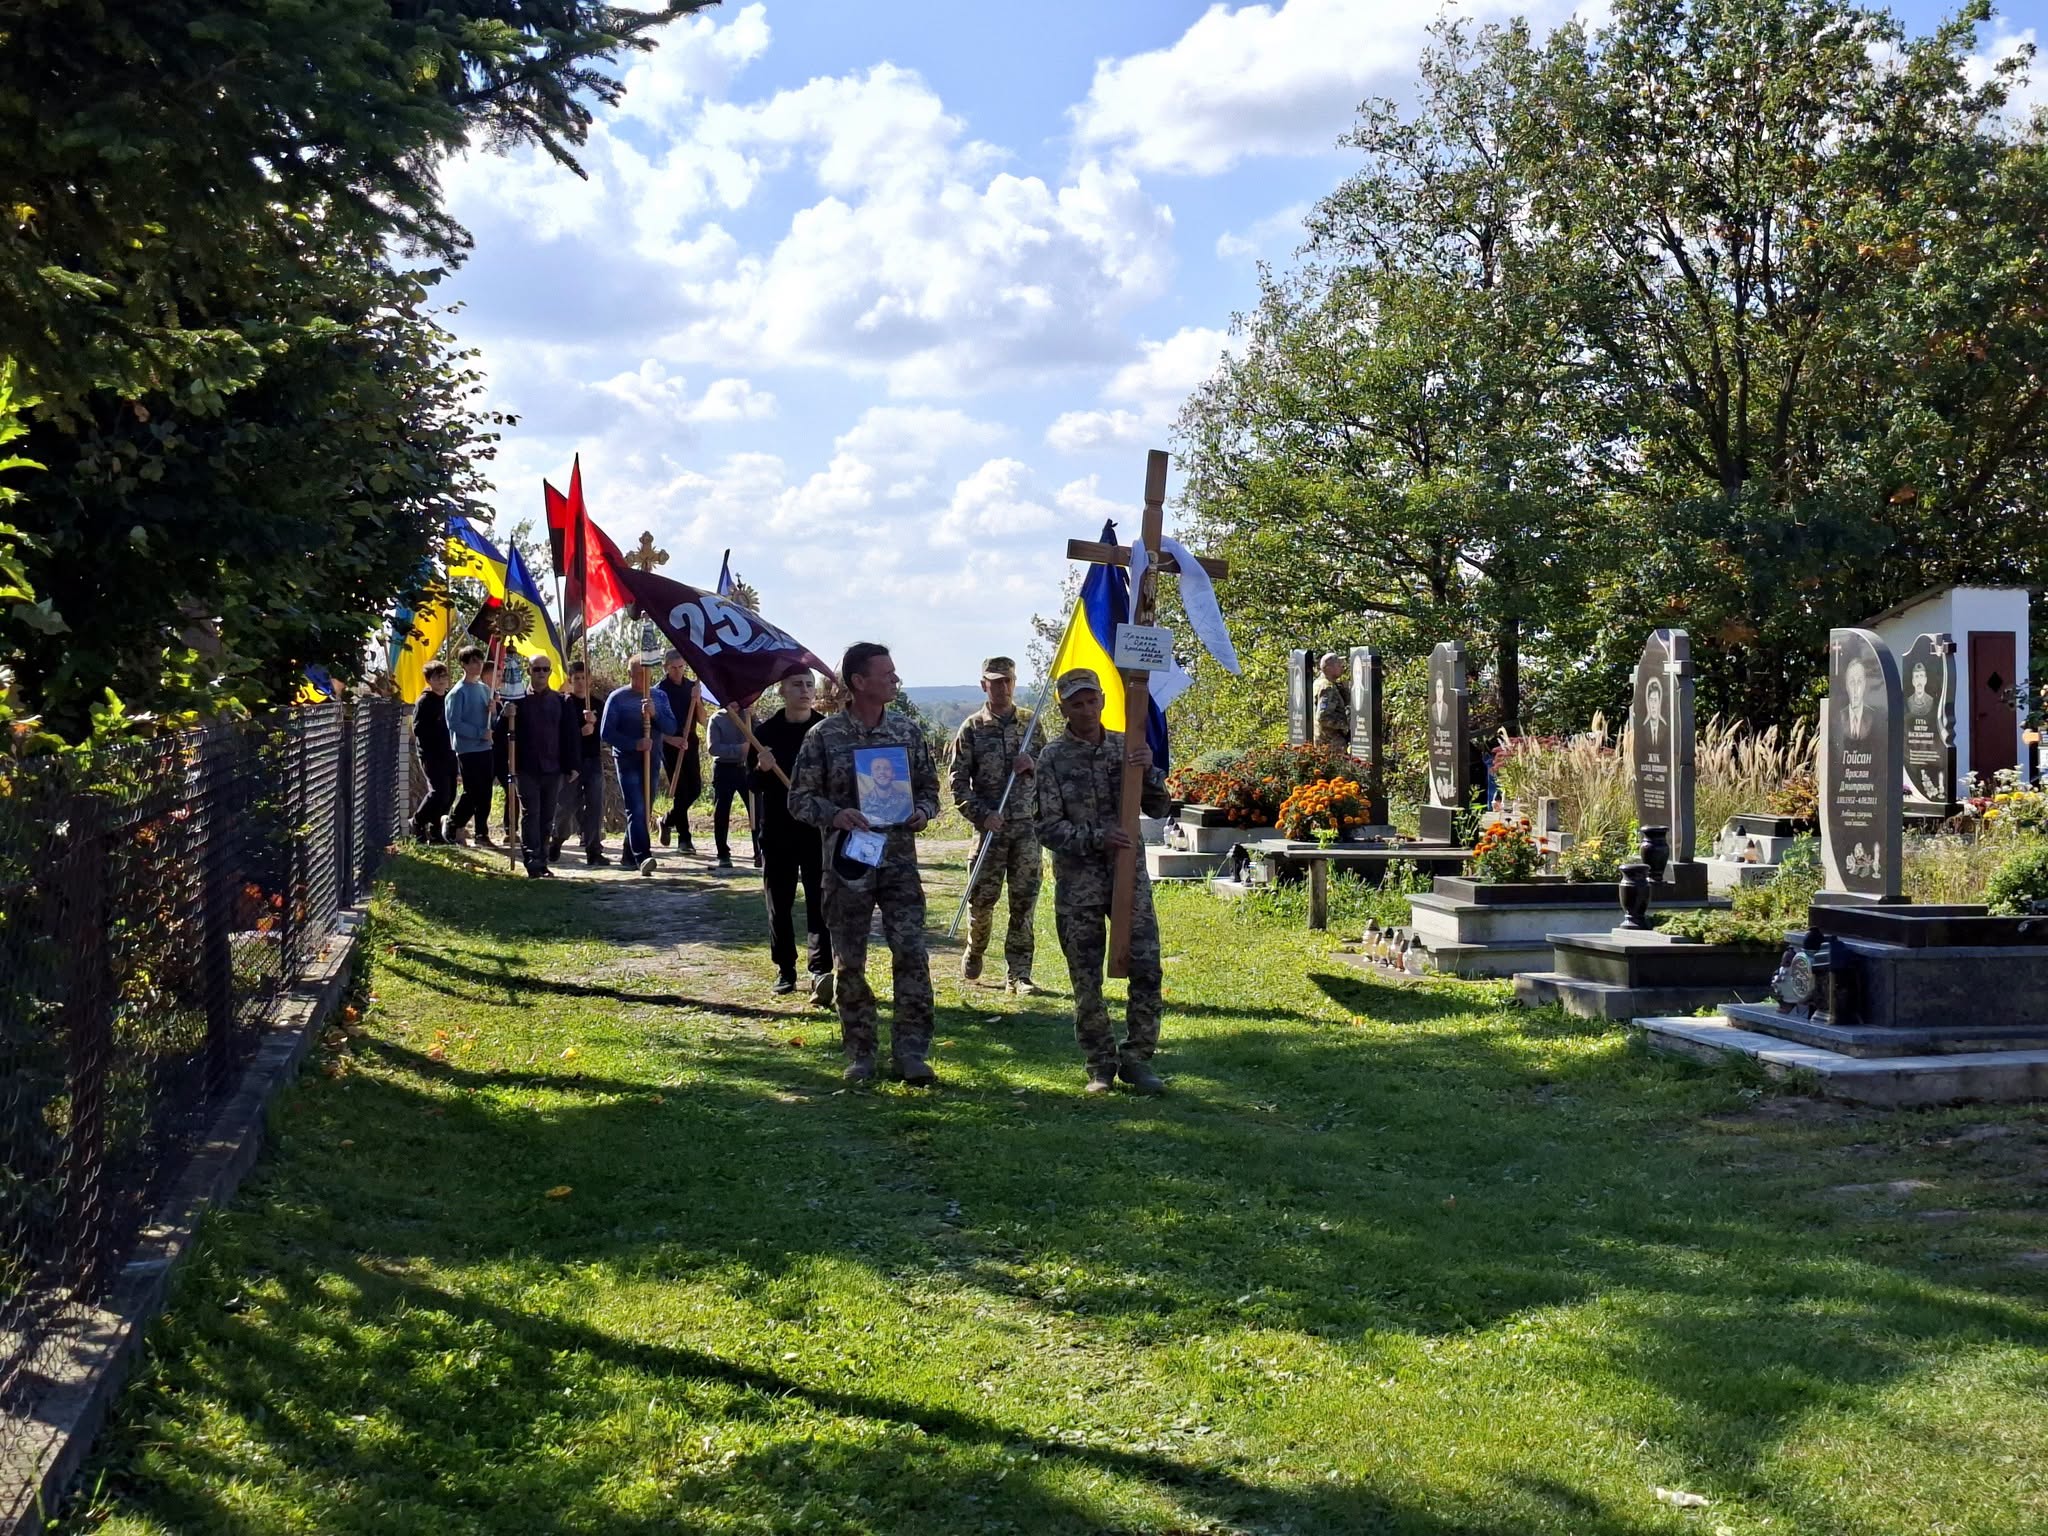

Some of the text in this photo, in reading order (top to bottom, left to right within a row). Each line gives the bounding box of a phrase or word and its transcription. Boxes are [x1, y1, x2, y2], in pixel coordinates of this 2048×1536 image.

[1842, 750, 1872, 765] Гойсан
[1844, 768, 1870, 781] Ярослав
[1839, 781, 1875, 793] Дмитрович
